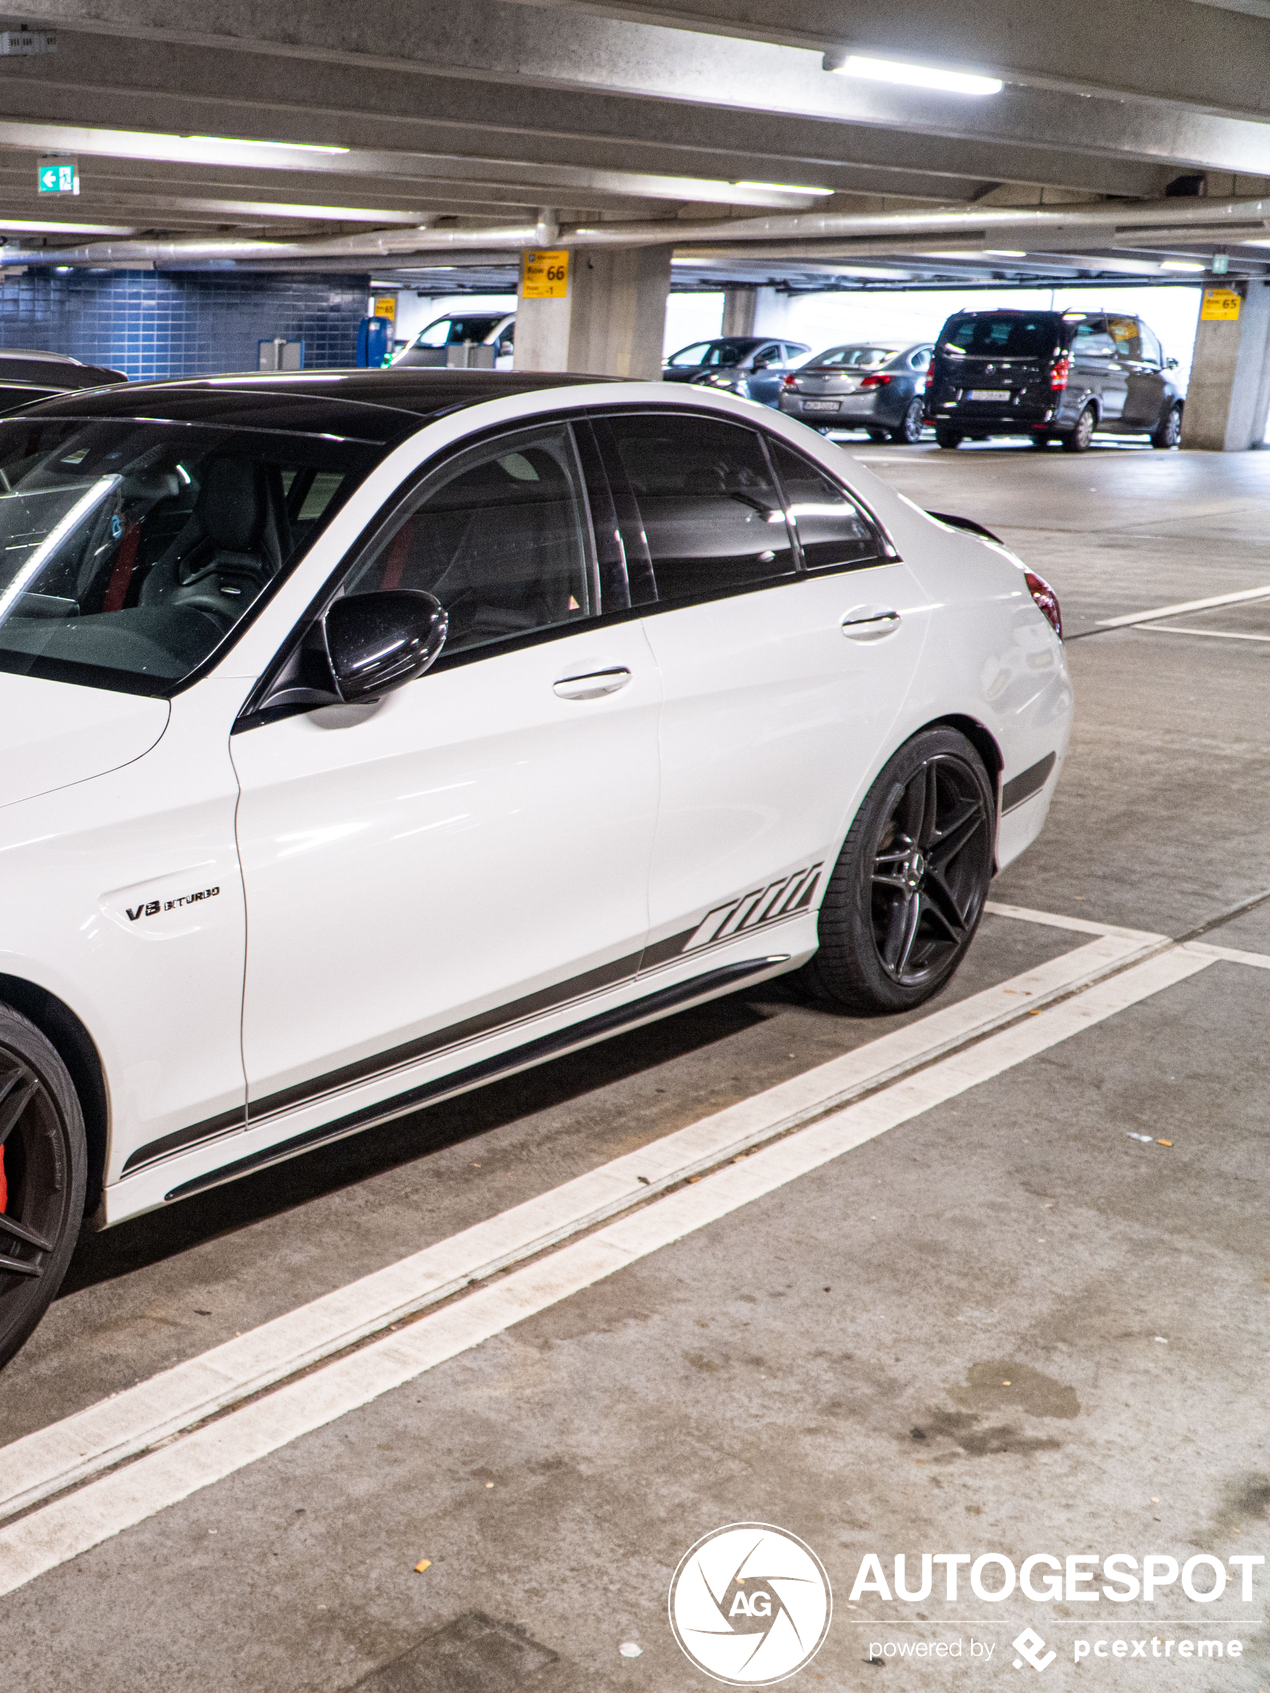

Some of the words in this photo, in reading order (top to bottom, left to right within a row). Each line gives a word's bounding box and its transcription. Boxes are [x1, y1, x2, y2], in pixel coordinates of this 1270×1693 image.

[547, 265, 564, 280] 66
[385, 305, 394, 314] 65
[1222, 299, 1237, 309] 65
[125, 900, 161, 921] V8
[164, 886, 220, 911] BITURBO
